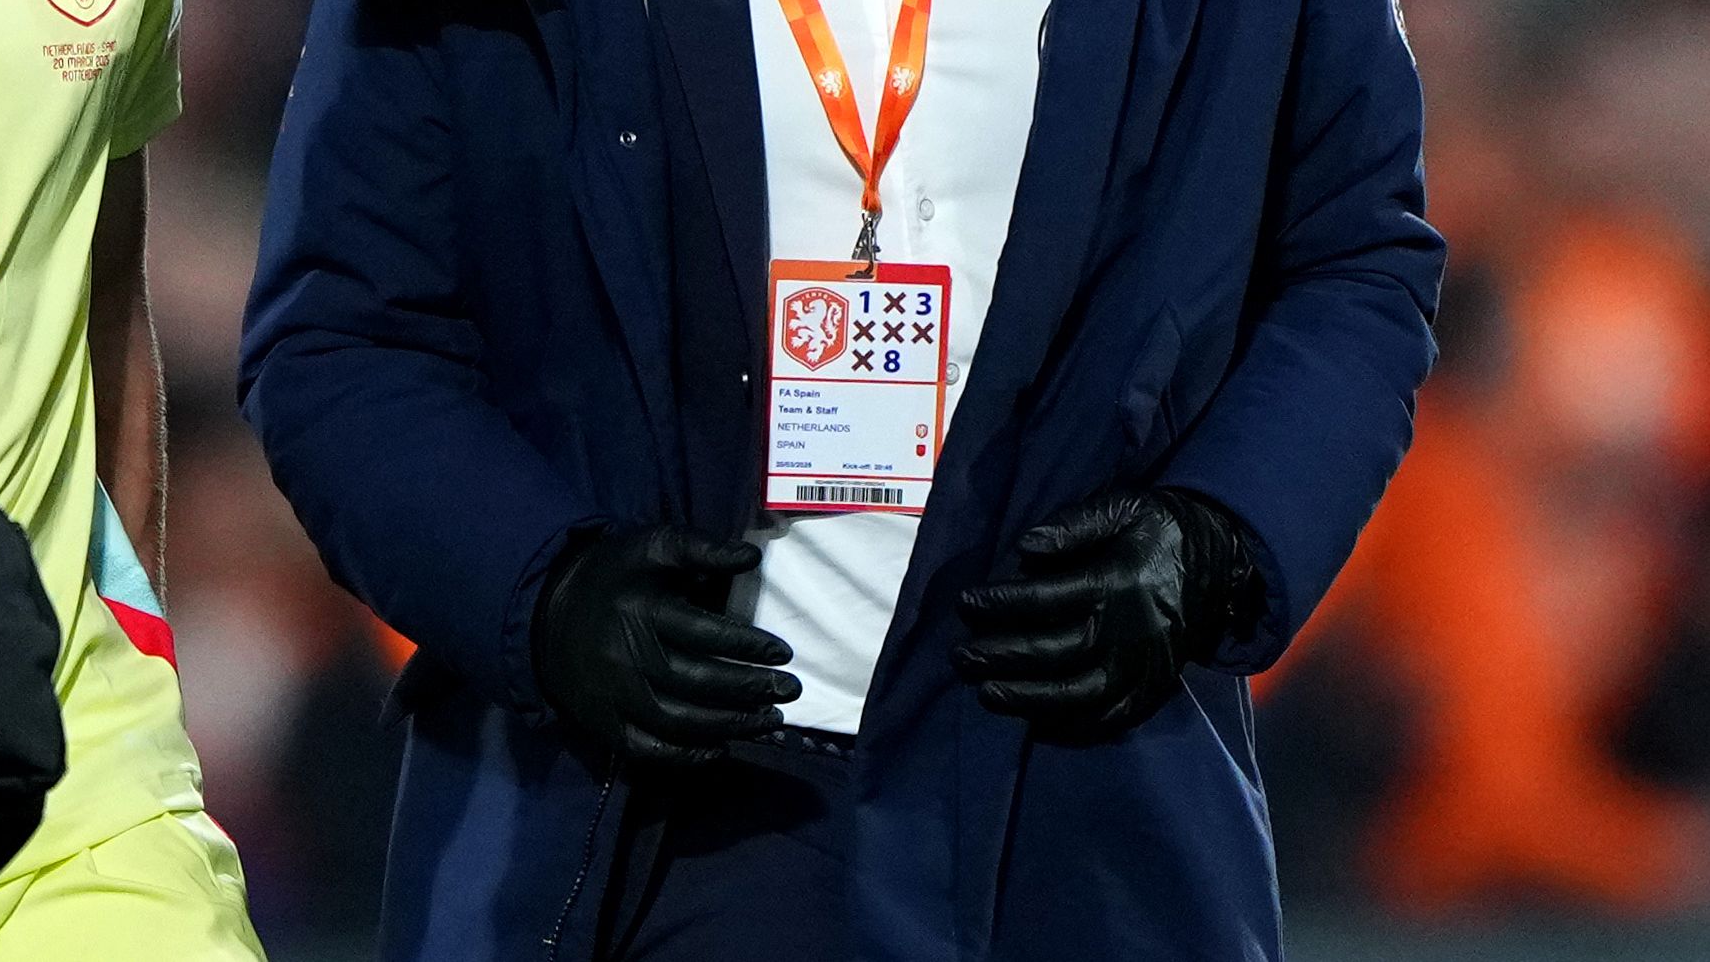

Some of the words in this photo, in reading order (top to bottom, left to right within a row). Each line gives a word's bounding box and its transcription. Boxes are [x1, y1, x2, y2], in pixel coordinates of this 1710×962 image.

[53, 58, 64, 70] 20
[858, 291, 870, 314] 1
[915, 292, 932, 316] 3
[883, 349, 901, 373] 8
[779, 388, 792, 397] FA
[793, 388, 821, 399] Spain
[778, 405, 803, 414] Team
[806, 406, 813, 414] &
[815, 406, 839, 415] Staff
[777, 422, 851, 433] NETHERLANDS
[776, 440, 806, 450] SPAIN
